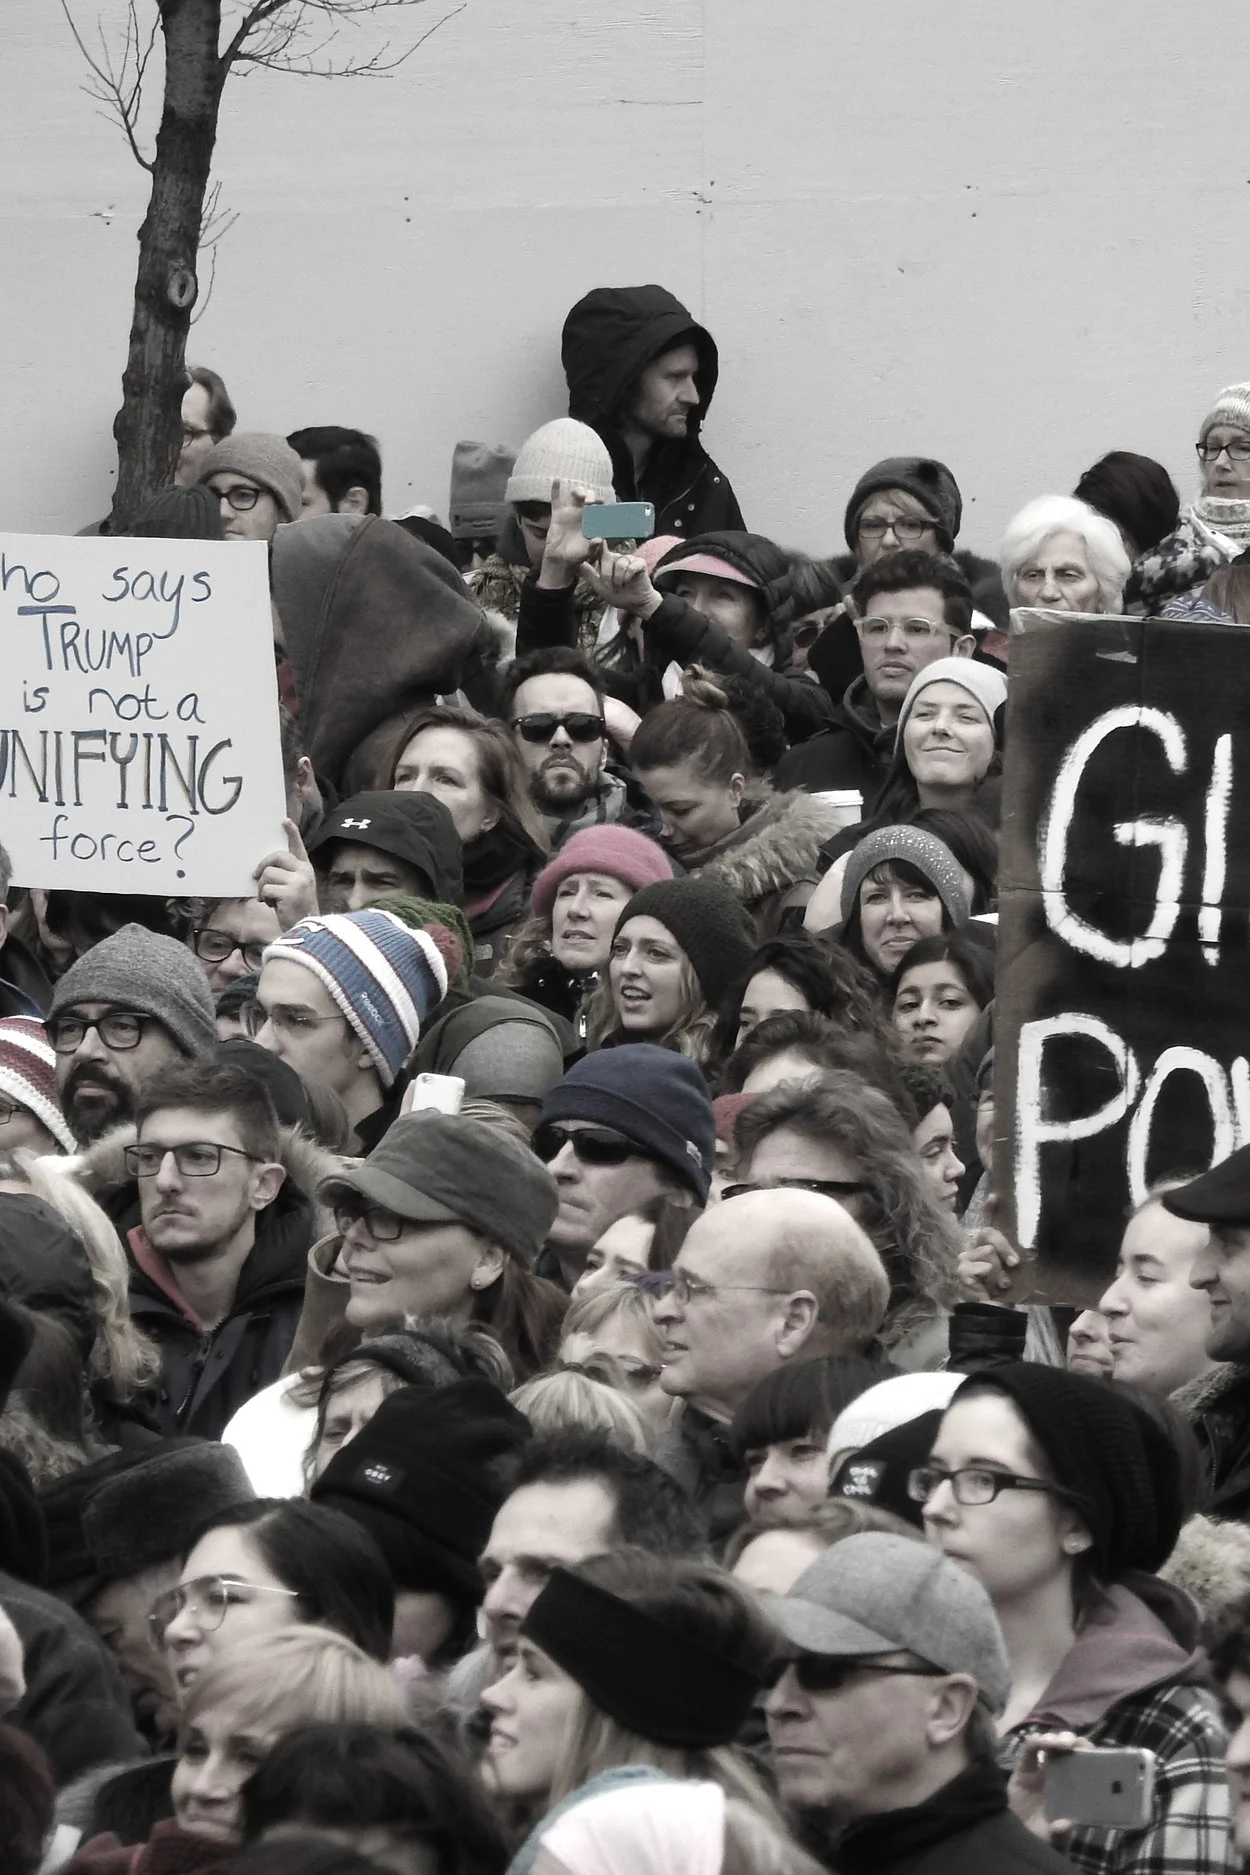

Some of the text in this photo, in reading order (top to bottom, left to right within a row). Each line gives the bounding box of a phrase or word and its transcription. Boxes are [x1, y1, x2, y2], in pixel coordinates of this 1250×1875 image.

[1, 552, 212, 639] ho says
[17, 605, 154, 677] TRUMP
[22, 680, 206, 724] is not a
[40, 814, 195, 878] force?
